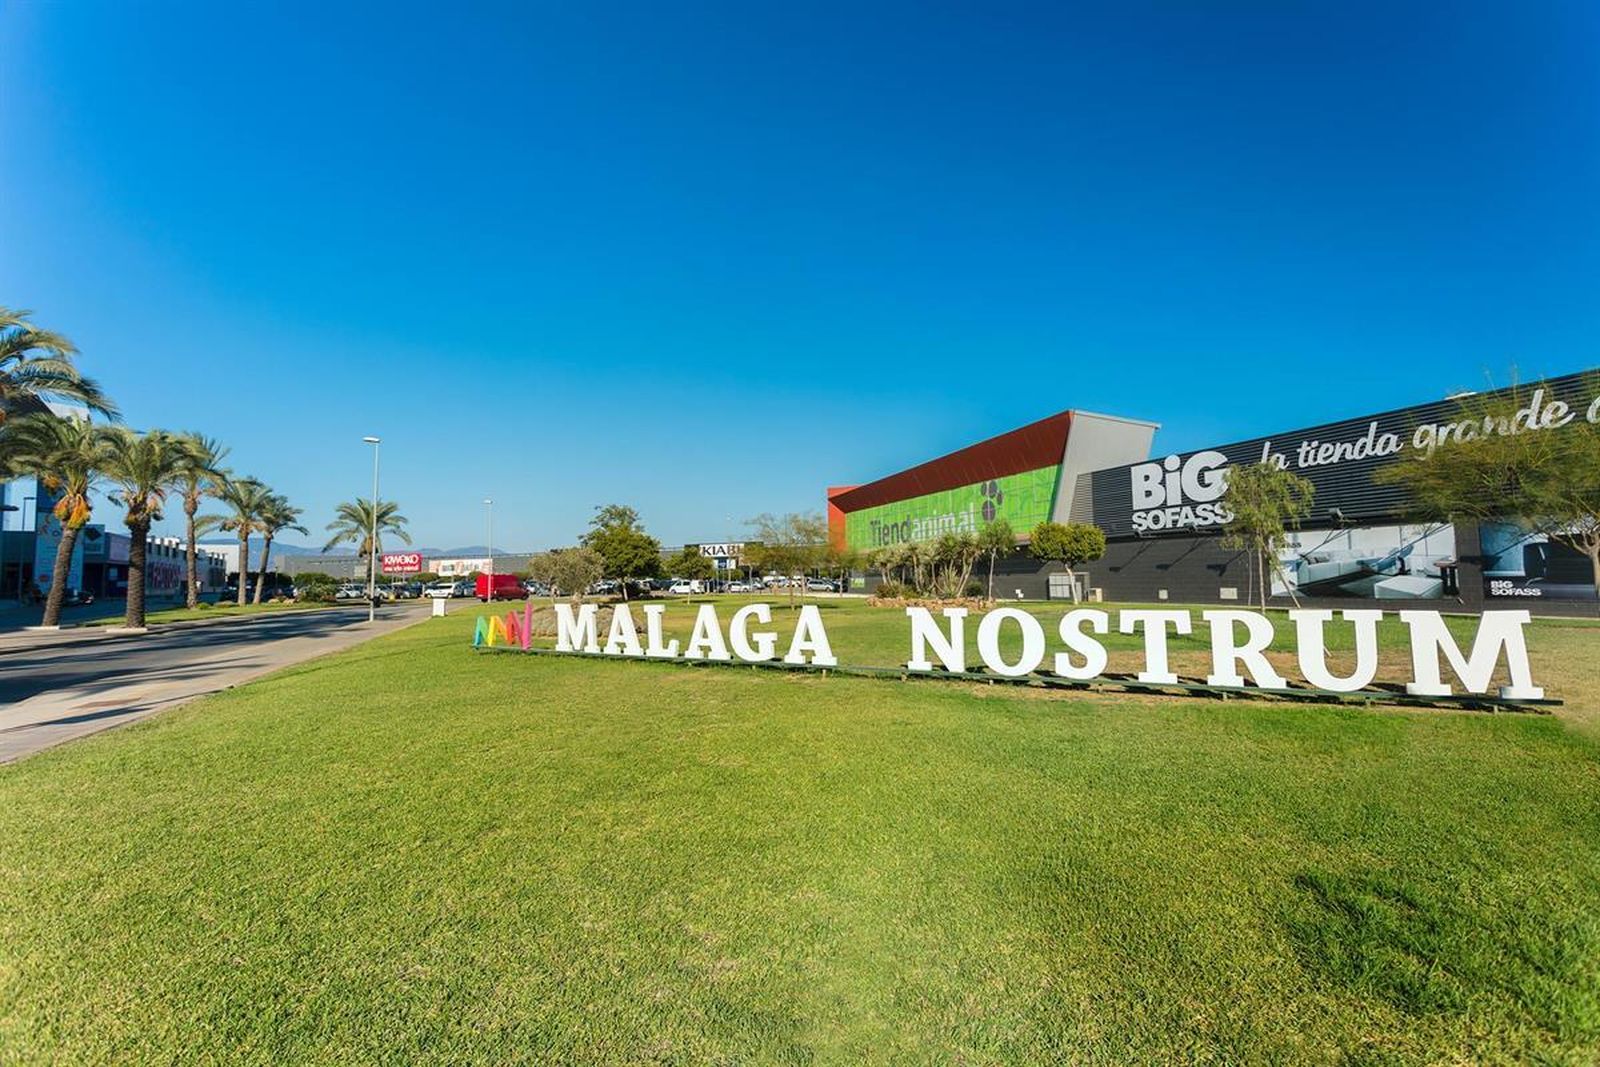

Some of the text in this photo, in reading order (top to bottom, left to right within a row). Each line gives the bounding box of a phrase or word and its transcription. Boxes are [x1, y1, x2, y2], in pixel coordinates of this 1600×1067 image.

[1260, 441, 1289, 471] la
[1297, 422, 1404, 468] tienda
[1412, 389, 1576, 461] grande
[870, 502, 976, 546] Tiendanimal
[1132, 501, 1234, 531] SOFASS
[1491, 588, 1542, 596] SOFASS
[554, 603, 1544, 700] MALAGA NOSTRUM
